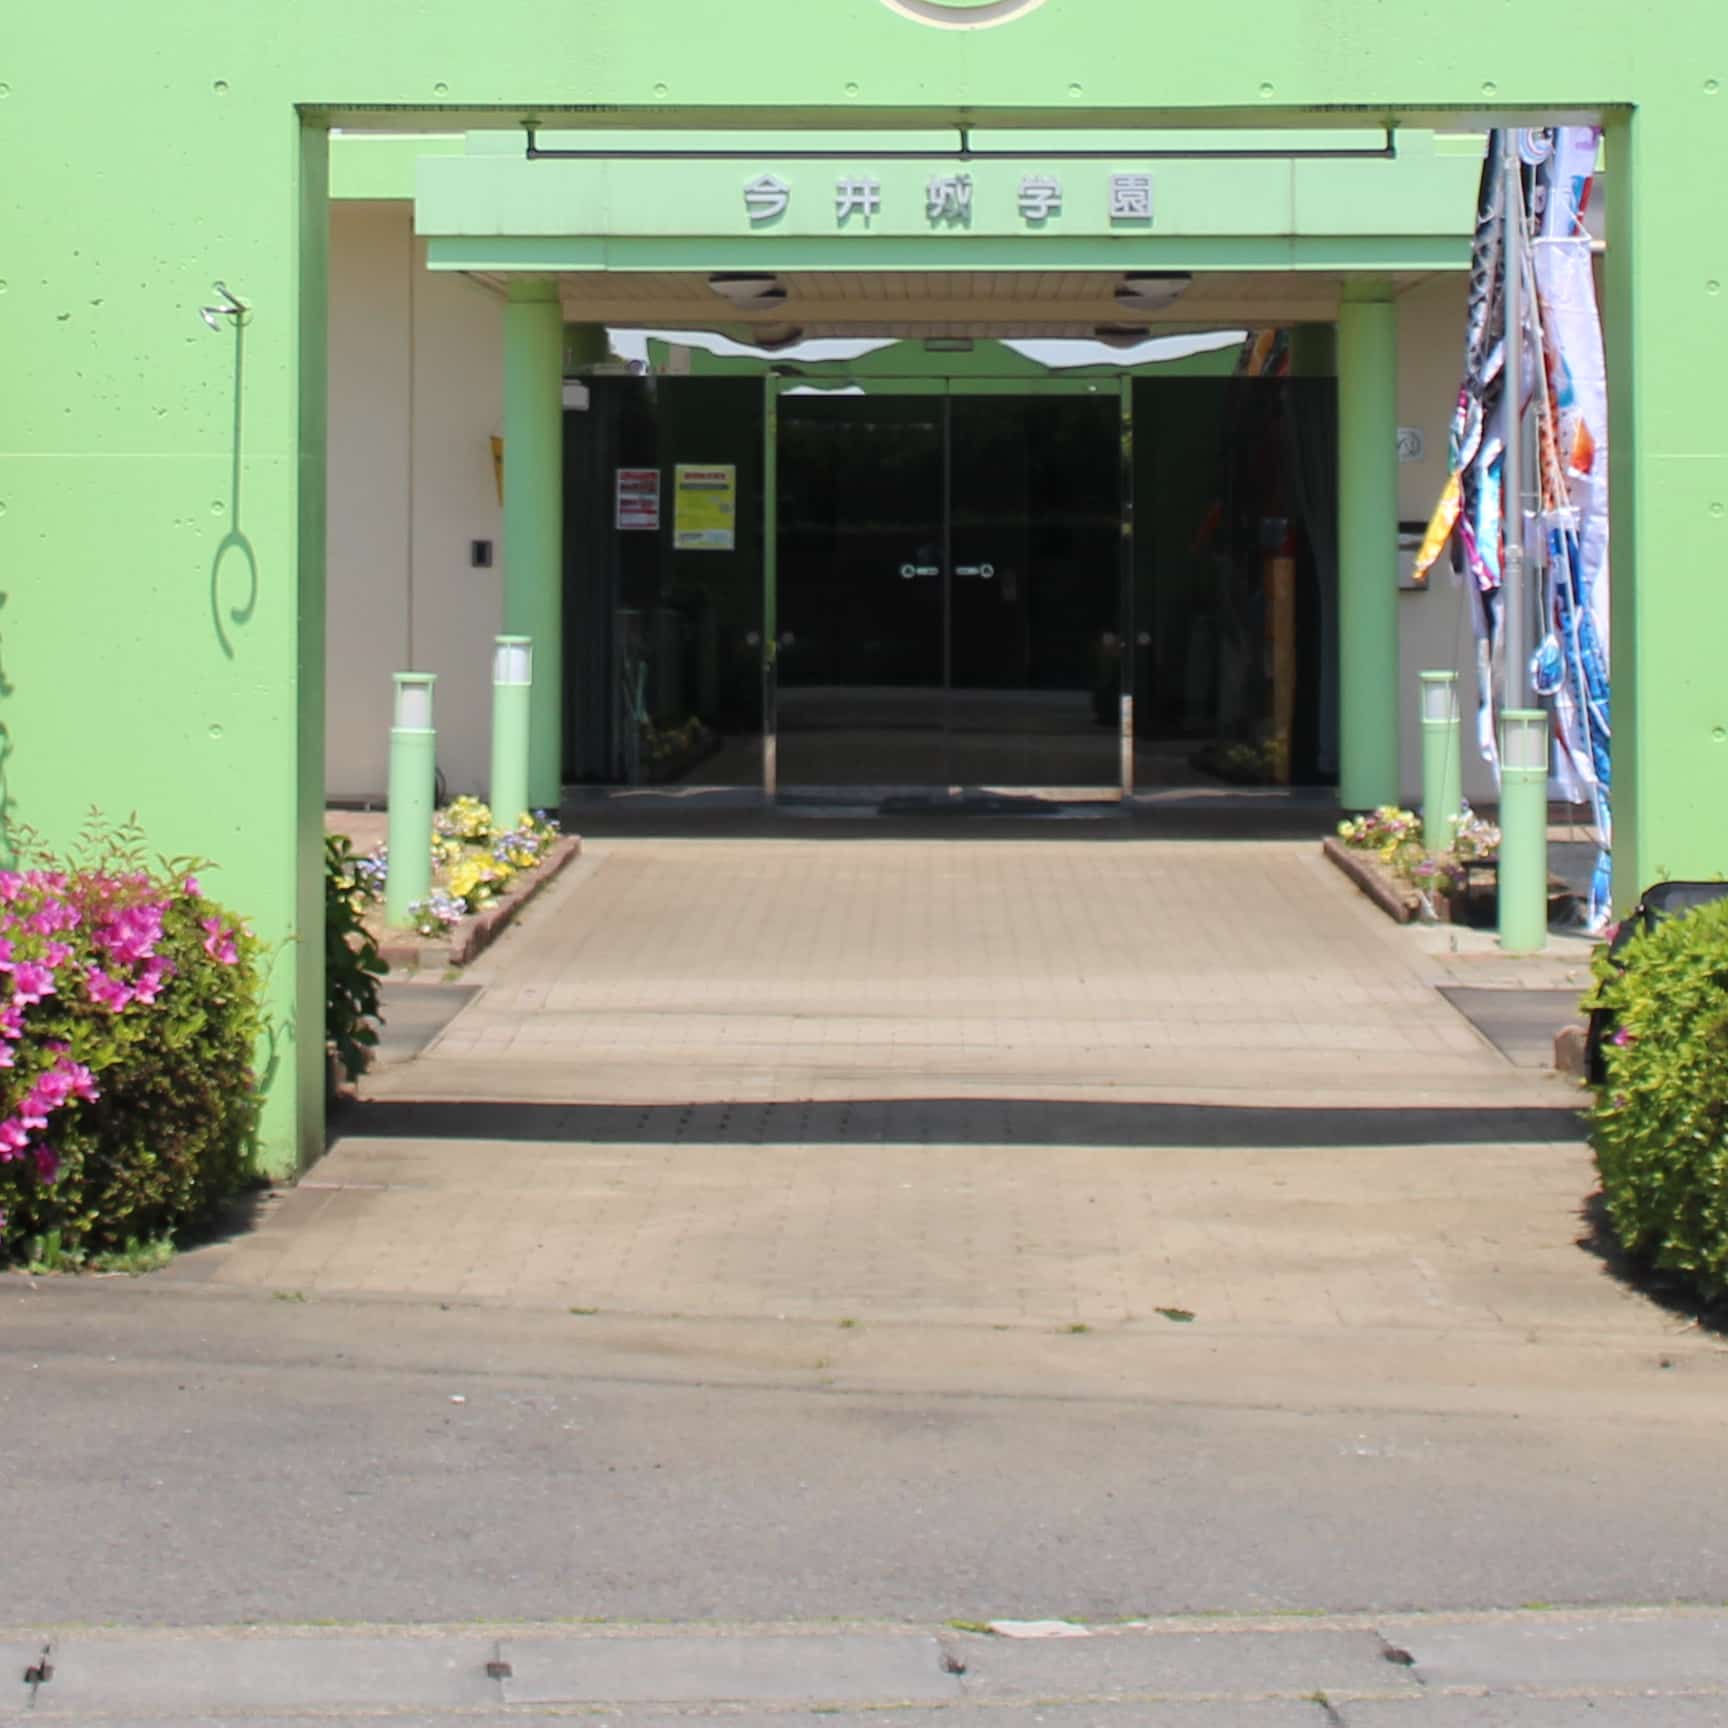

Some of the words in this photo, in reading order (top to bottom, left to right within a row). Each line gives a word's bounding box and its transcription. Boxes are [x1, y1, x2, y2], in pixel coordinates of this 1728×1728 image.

[744, 174, 1154, 221] 今井城学園
